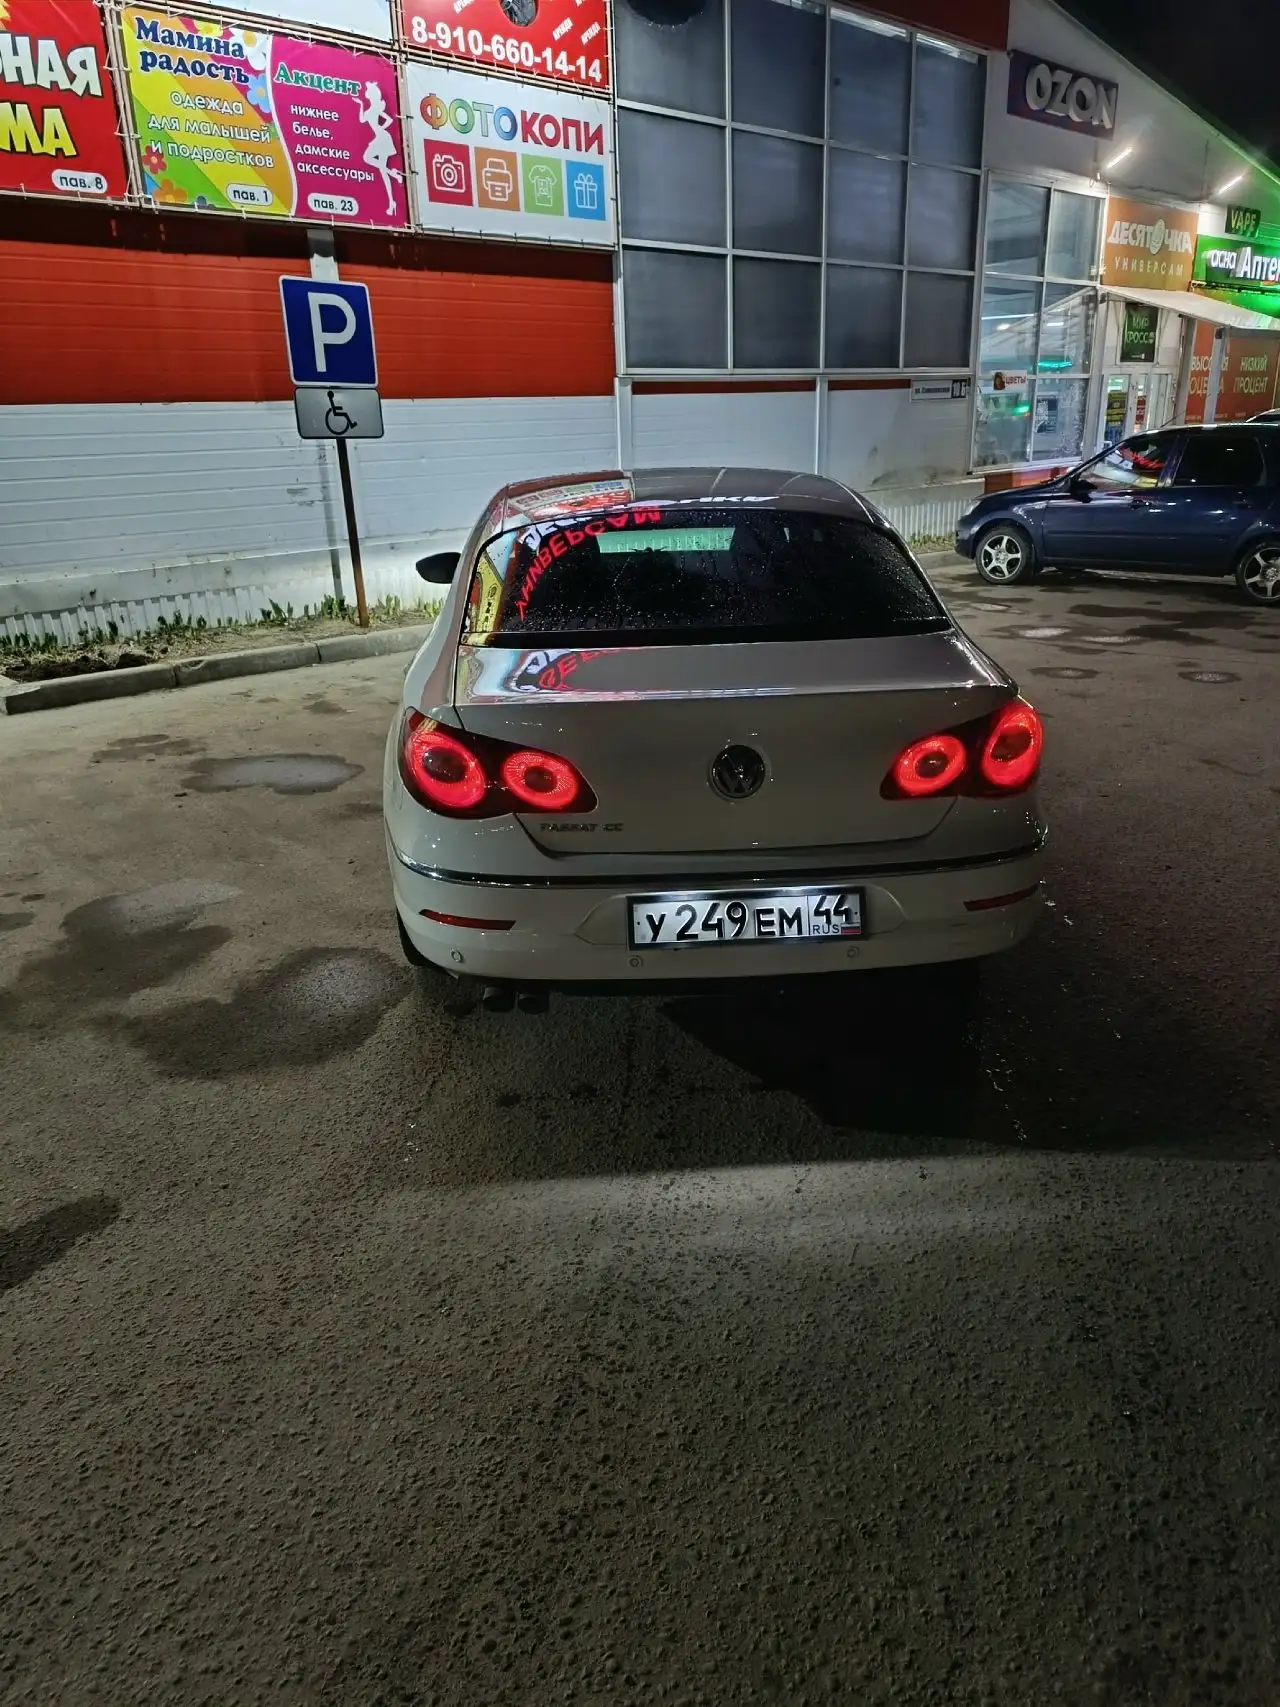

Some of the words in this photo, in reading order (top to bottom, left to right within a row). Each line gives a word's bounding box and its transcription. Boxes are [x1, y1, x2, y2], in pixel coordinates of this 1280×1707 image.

[135, 17, 245, 58] Мамина
[411, 16, 602, 82] 8-910-660-14-14
[0, 33, 102, 97] НАЯ
[139, 50, 250, 83] радость
[274, 62, 361, 96] Акцент
[170, 91, 244, 116] одежда
[1025, 63, 1117, 129] OZON
[290, 104, 339, 121] нижнее
[148, 114, 180, 131] для
[185, 119, 271, 143] малышей
[292, 121, 334, 140] белье,
[151, 140, 163, 154] и
[167, 142, 274, 168] подростков
[295, 144, 350, 160] дамские
[60, 175, 91, 188] пав.
[95, 177, 103, 189] 8
[297, 162, 375, 182] аксессуары
[233, 189, 260, 201] пав.
[263, 190, 268, 202] 1
[313, 198, 338, 210] пав.
[341, 200, 354, 212] 23
[1231, 208, 1256, 232] VAPE
[1107, 219, 1193, 254] ДЕСЯТОЧКА
[1114, 256, 1184, 276] УНИВЕРСАМ
[307, 291, 357, 373] P
[1132, 315, 1149, 329] МИР
[1240, 353, 1268, 371] НИЗКИЙ
[1005, 376, 1026, 385] ЦВЕТЫ
[1233, 376, 1268, 396] ПРОЦЕНТ
[540, 822, 598, 832] PASSAT
[602, 822, 624, 832] CC
[813, 894, 852, 925] 44
[812, 924, 840, 935] RUS
